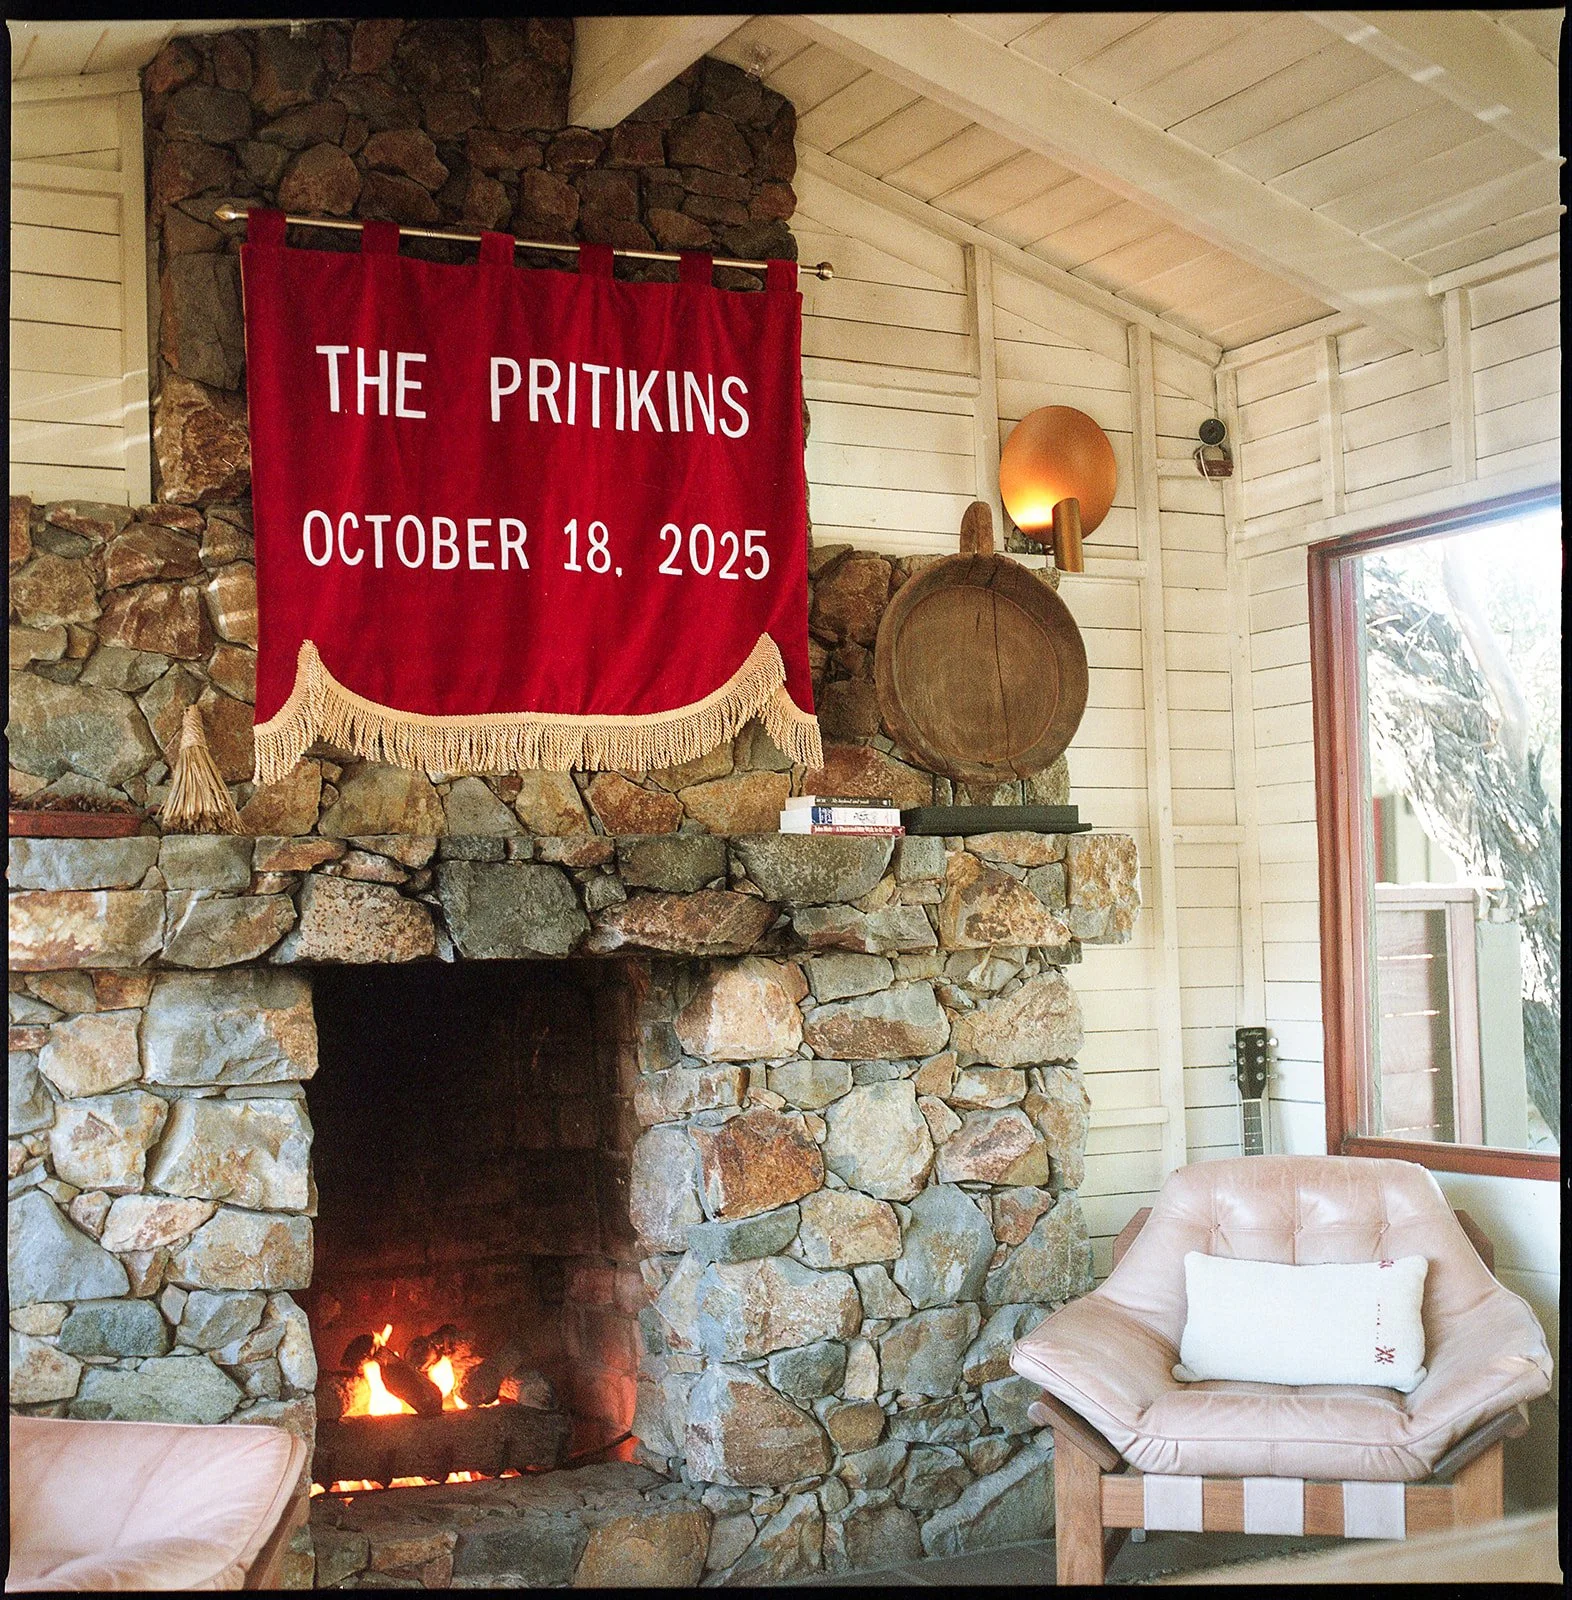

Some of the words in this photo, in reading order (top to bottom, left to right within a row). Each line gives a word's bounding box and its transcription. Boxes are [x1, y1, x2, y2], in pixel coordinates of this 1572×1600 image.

[315, 345, 427, 419] THE
[490, 356, 750, 439] PRITIKINS
[302, 509, 530, 571] OCTOBER
[563, 518, 623, 578] 18,
[658, 523, 770, 580] 2025
